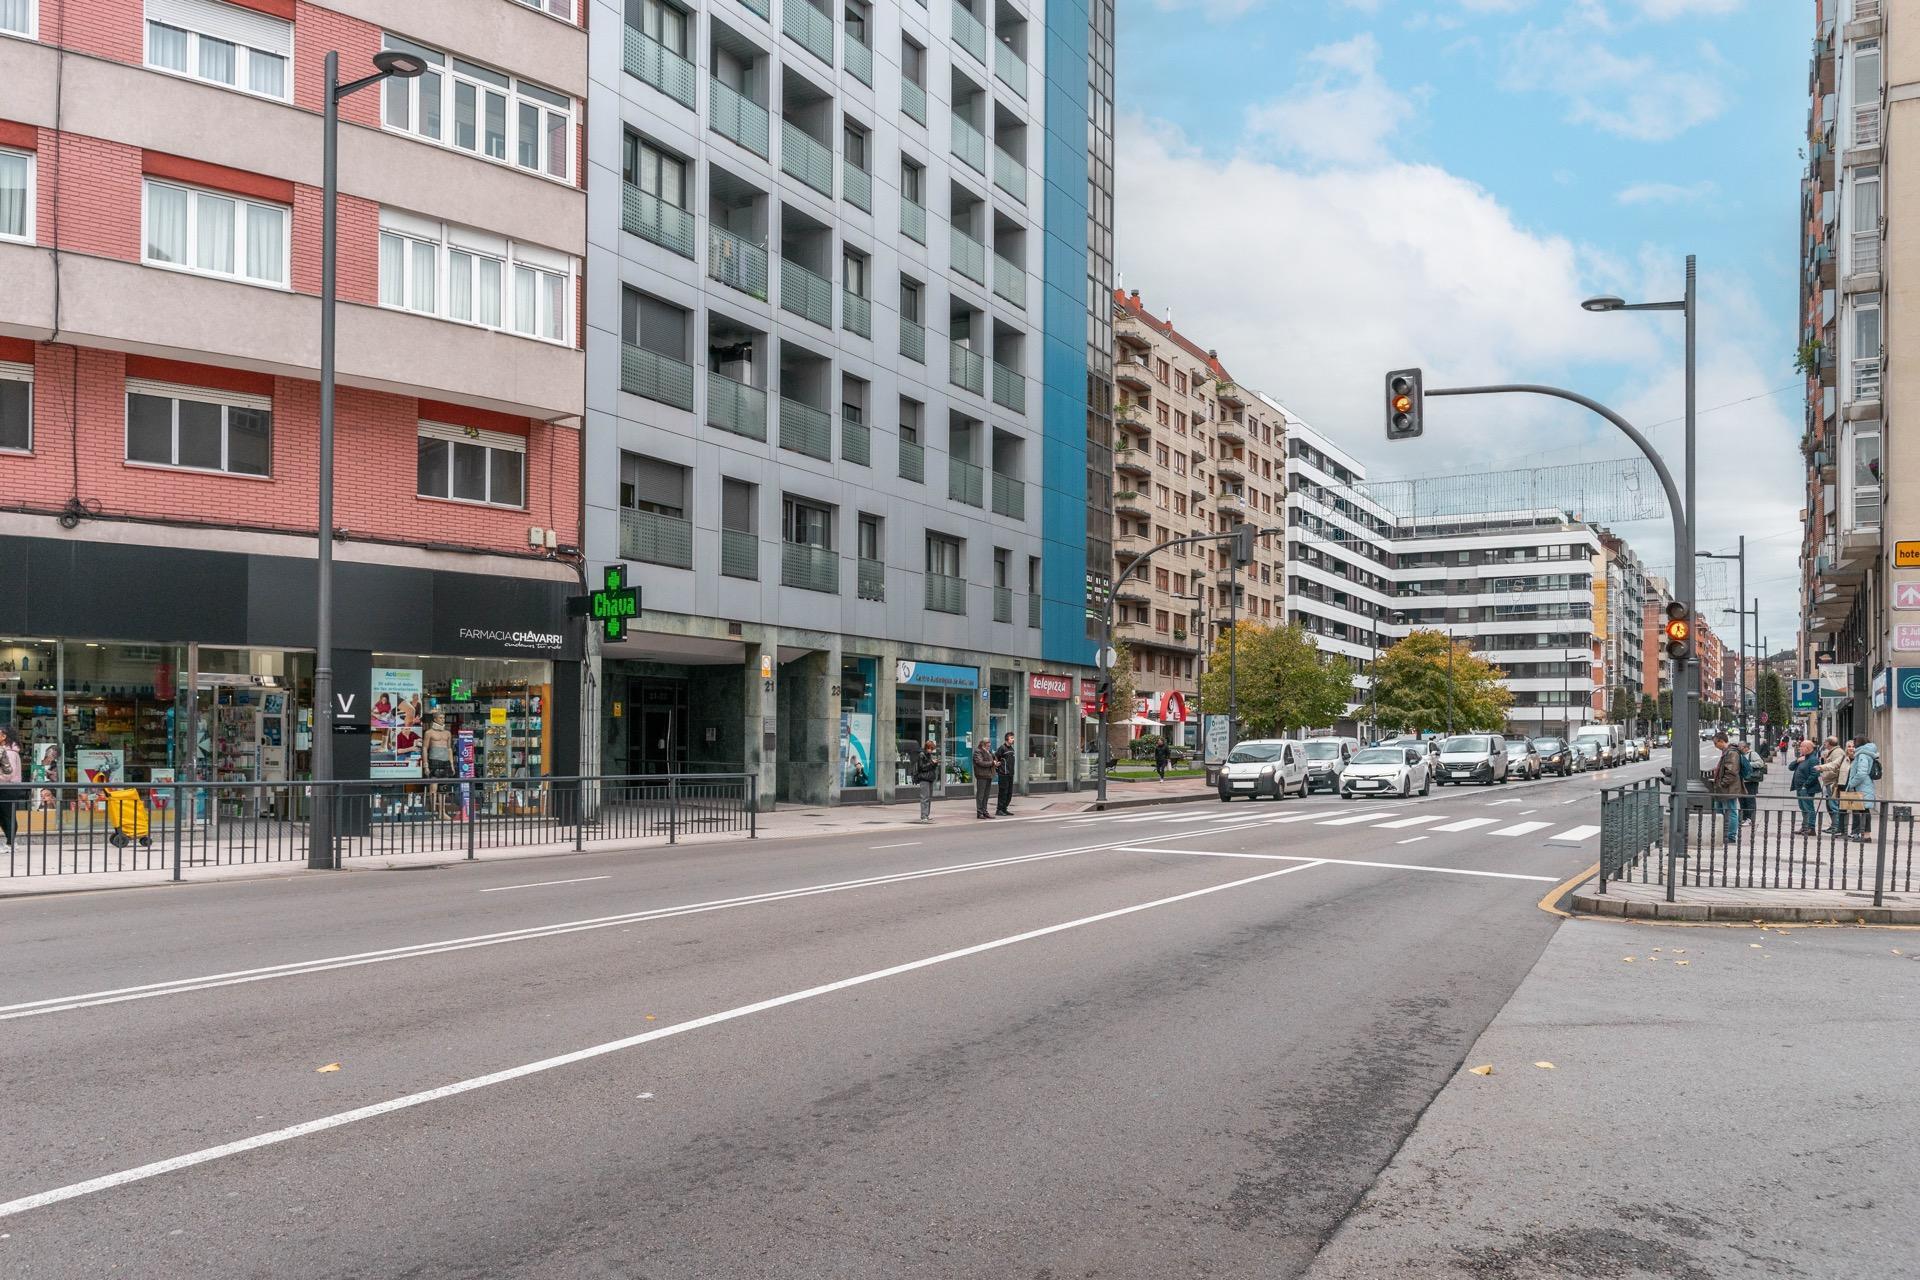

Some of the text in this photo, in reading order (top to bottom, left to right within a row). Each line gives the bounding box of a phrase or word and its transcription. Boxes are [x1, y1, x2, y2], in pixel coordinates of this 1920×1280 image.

[459, 628, 562, 644] FARMACIA CHAVARRI
[764, 680, 775, 692] 21
[1033, 677, 1066, 695] telepizza
